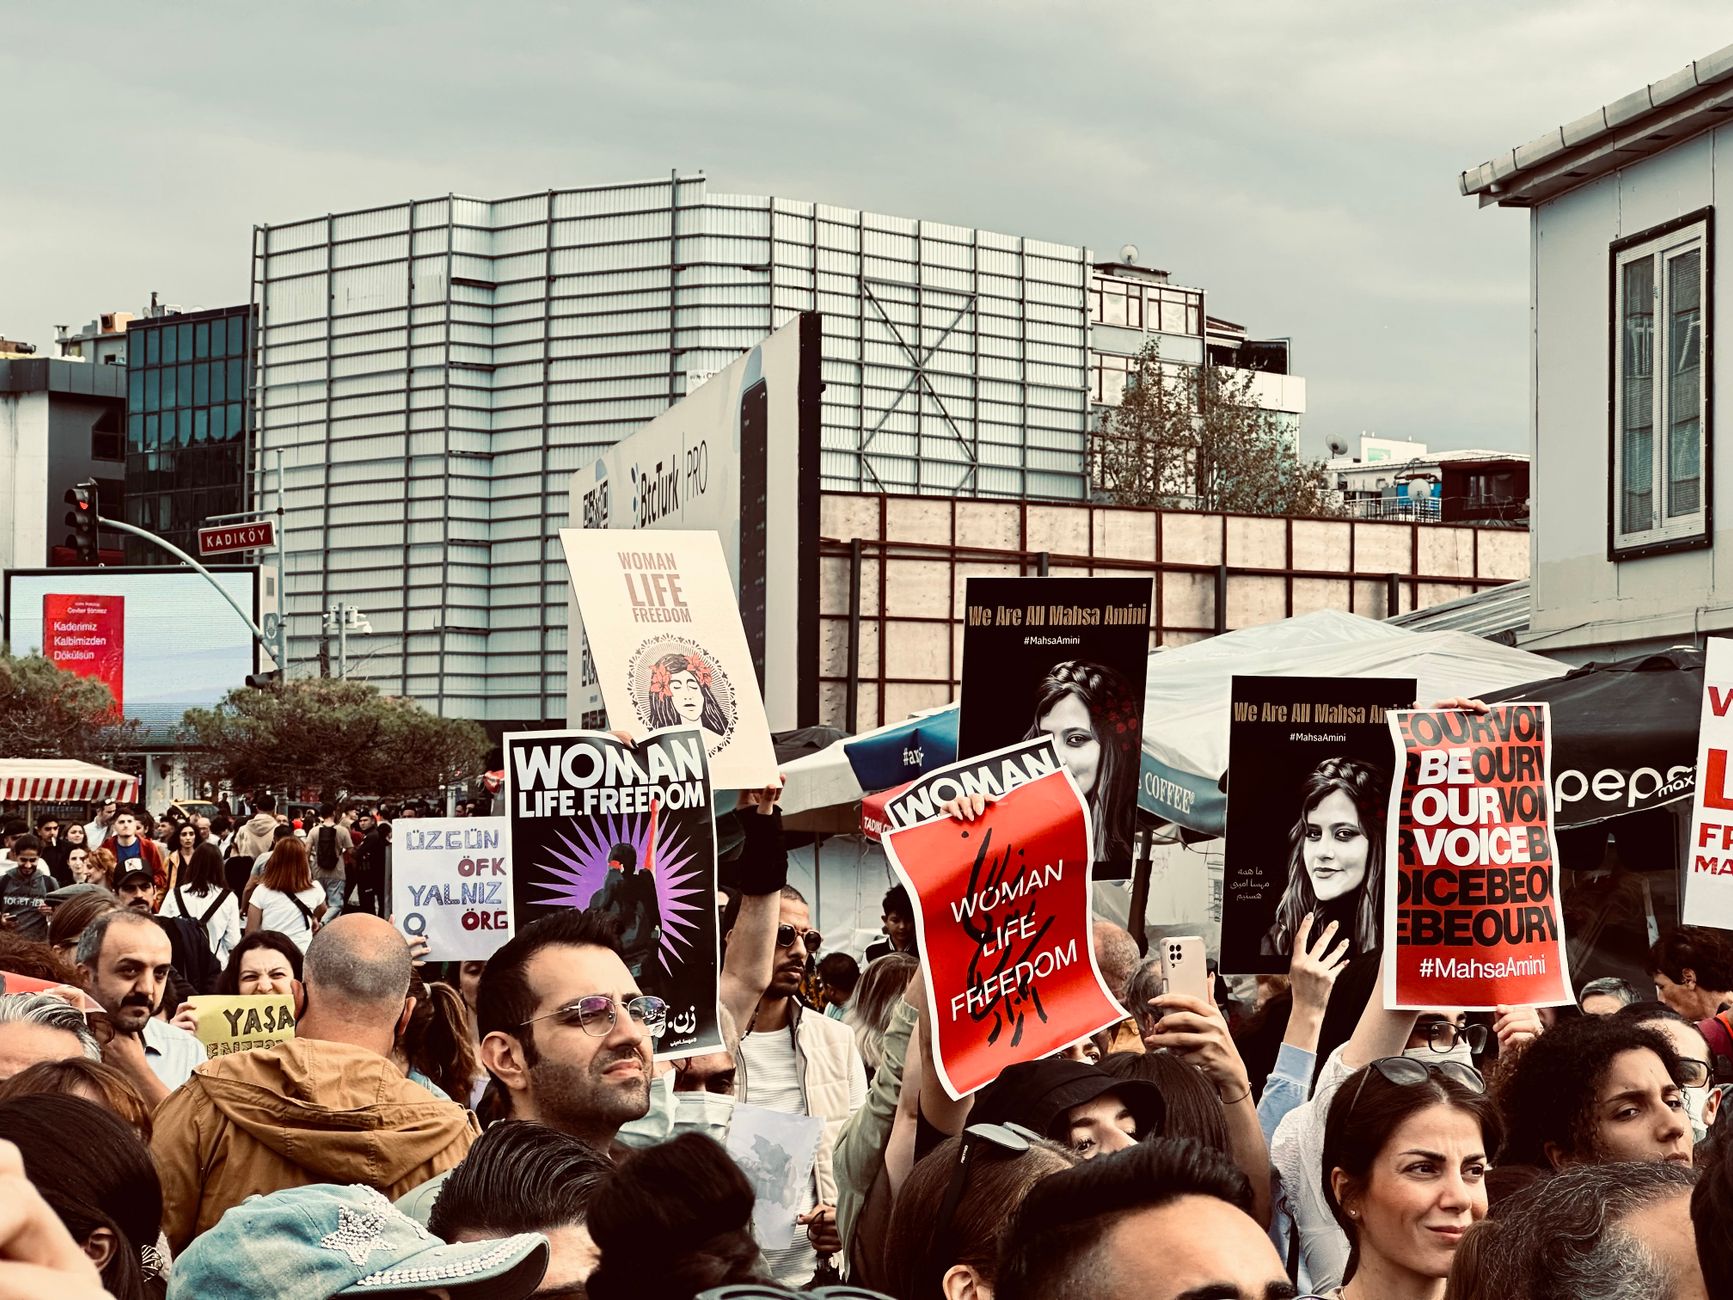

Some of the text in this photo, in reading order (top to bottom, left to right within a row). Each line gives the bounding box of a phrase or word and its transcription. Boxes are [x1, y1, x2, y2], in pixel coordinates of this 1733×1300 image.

[641, 440, 708, 528] BtcTurk PRO
[206, 528, 265, 548] KADIKÖY
[617, 552, 677, 571] WOMAN
[624, 573, 688, 608] LIFE
[632, 608, 692, 623] FREEDOM
[969, 603, 1147, 626] We Are All Mahsa Amini
[54, 622, 97, 631] Kaderimiz
[54, 636, 106, 646] Kalbimizden
[1023, 635, 1081, 646] #MahsaAmini
[1234, 702, 1258, 722] We
[1261, 702, 1288, 723] Are
[1291, 703, 1311, 723] All
[1315, 703, 1366, 724] Mahsa
[1289, 733, 1347, 743] #MahsaAmini
[513, 738, 704, 791] WOMAN
[893, 748, 1062, 828] WOMAN
[1658, 775, 1695, 798] max
[406, 828, 499, 850] ÜZGÜN
[408, 882, 502, 907] YALNIZ
[950, 859, 1063, 923] WOMAN
[981, 912, 1037, 957] LIFE
[1419, 954, 1546, 979] #MahsaAmini
[951, 938, 1078, 1022] FREEDOM
[222, 1005, 296, 1037] YAŞA
